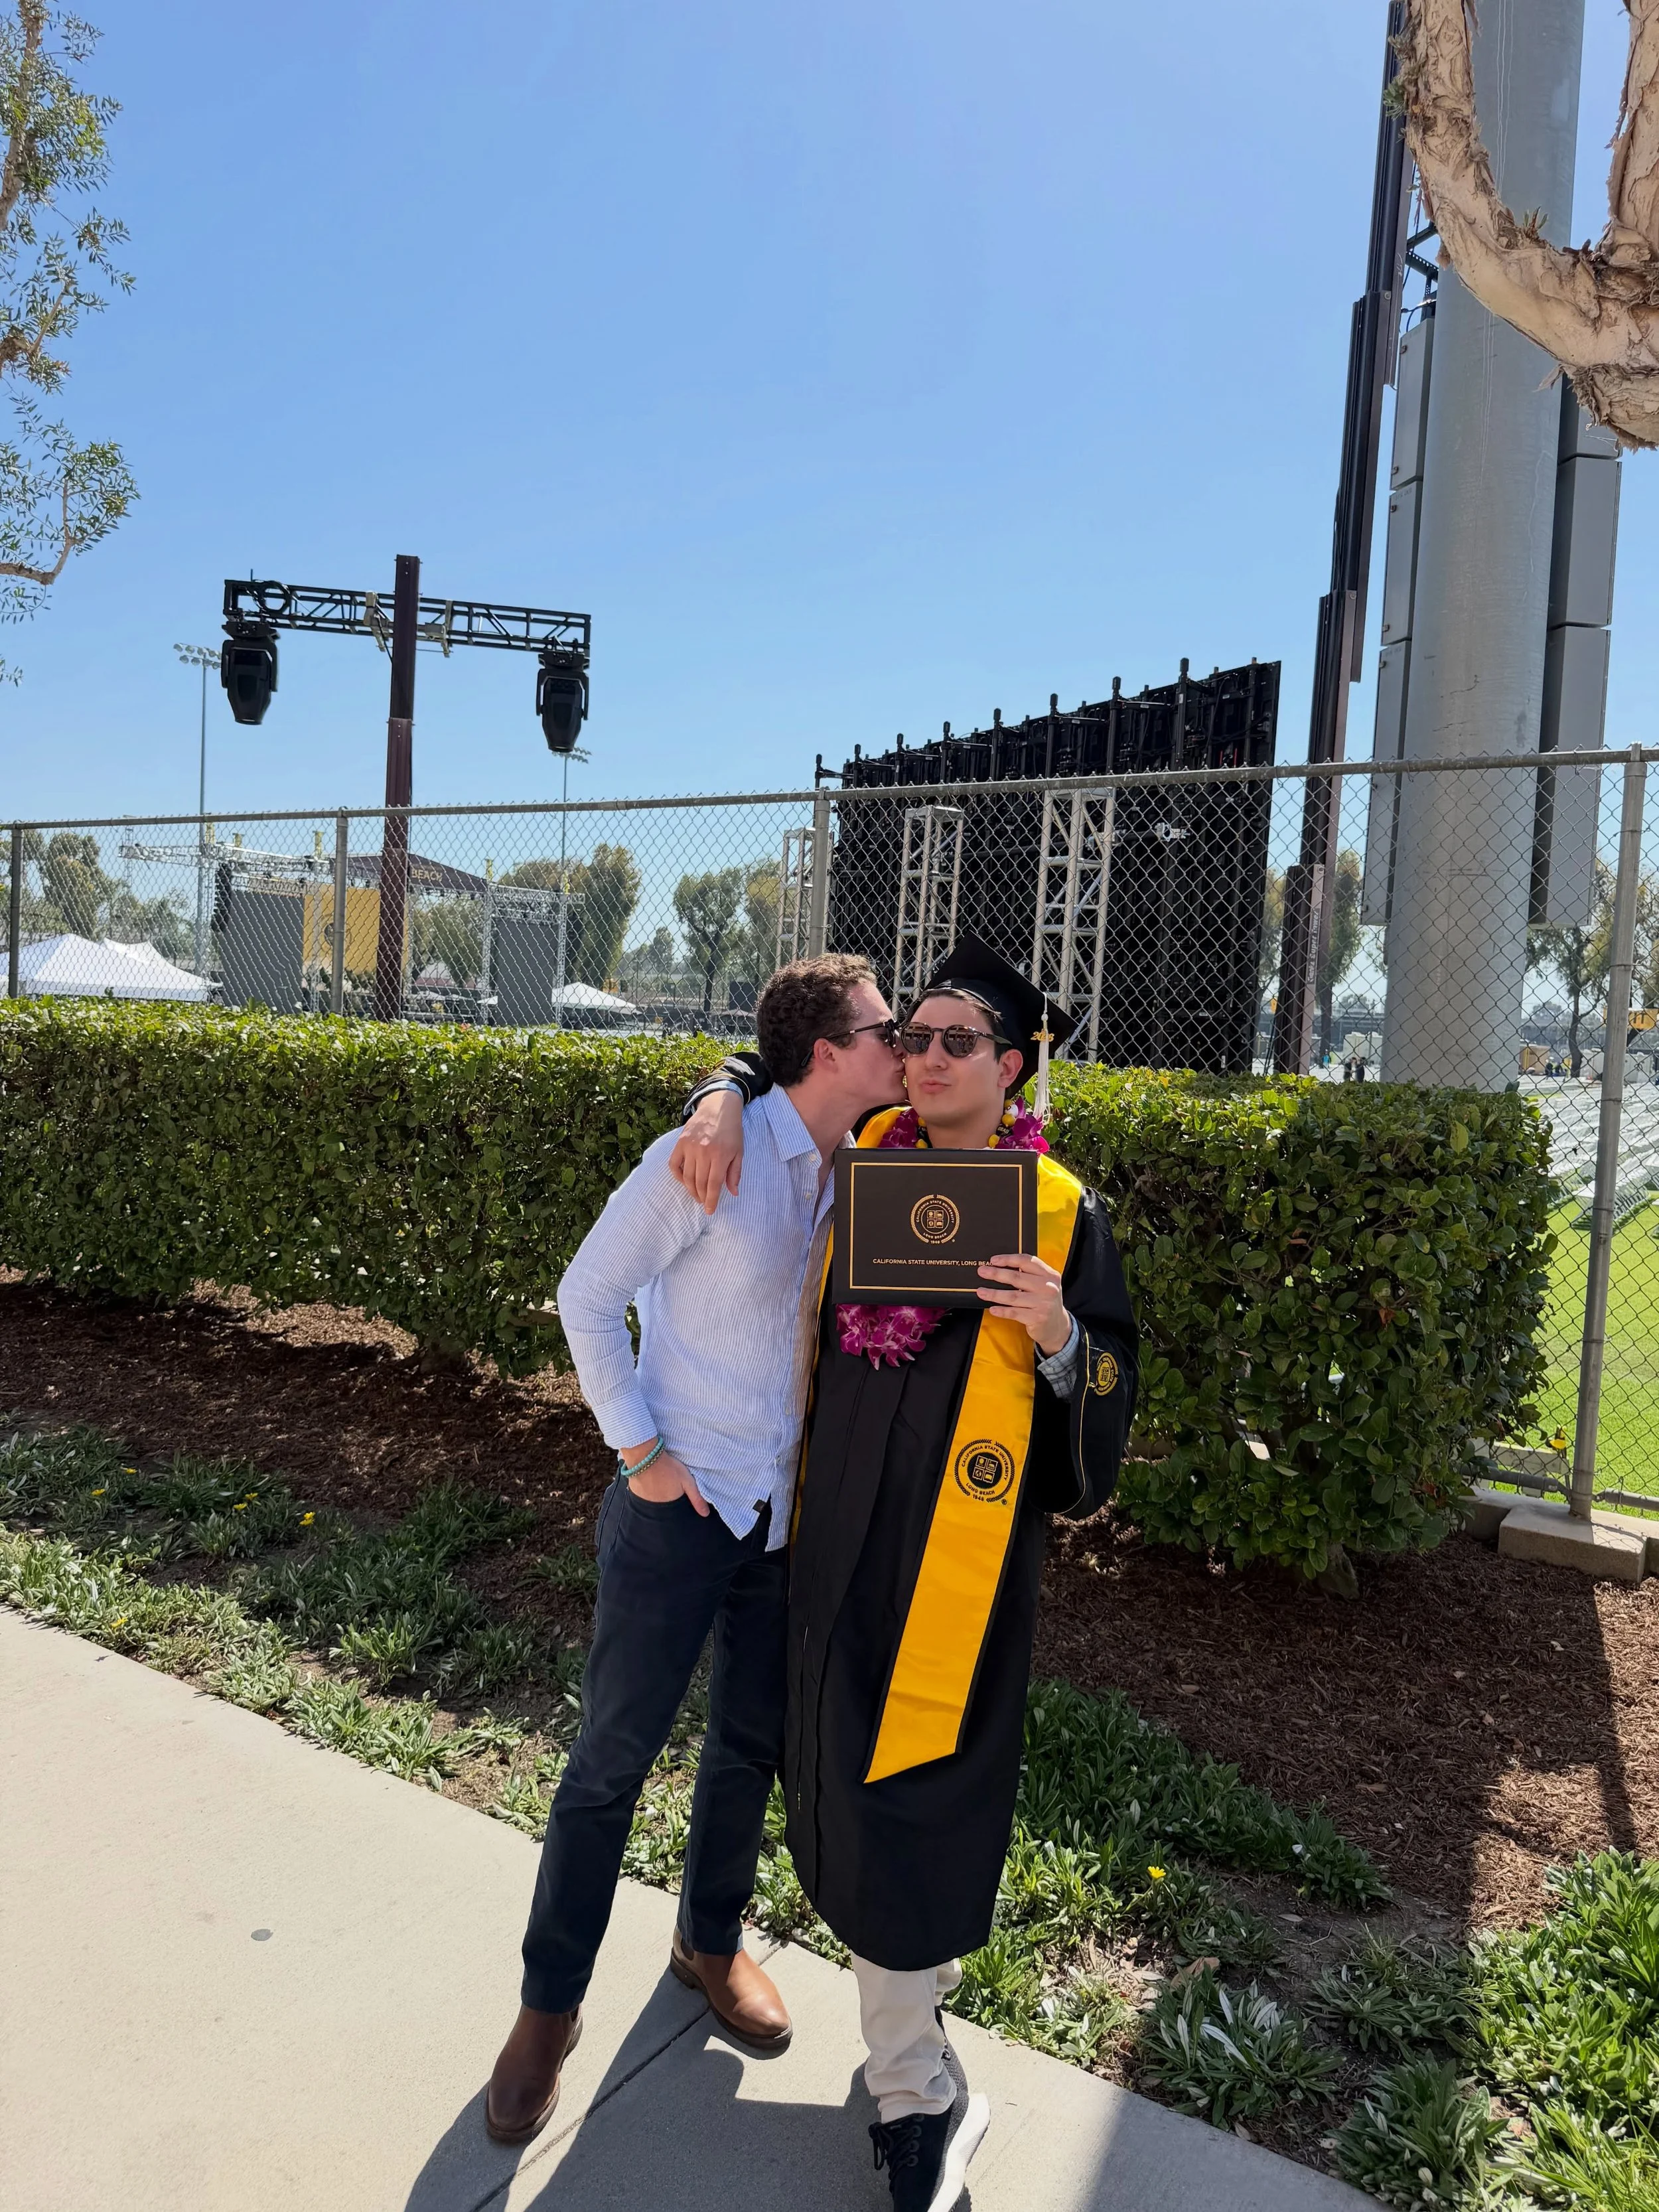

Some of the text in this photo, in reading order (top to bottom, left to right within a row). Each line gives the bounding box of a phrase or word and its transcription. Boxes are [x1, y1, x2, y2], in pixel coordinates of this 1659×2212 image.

[411, 869, 443, 881] BEACH
[962, 1445, 983, 1467] CALIFORNIA
[999, 1451, 1009, 1481] UNIVERSITY
[966, 1482, 978, 1493] LONG
